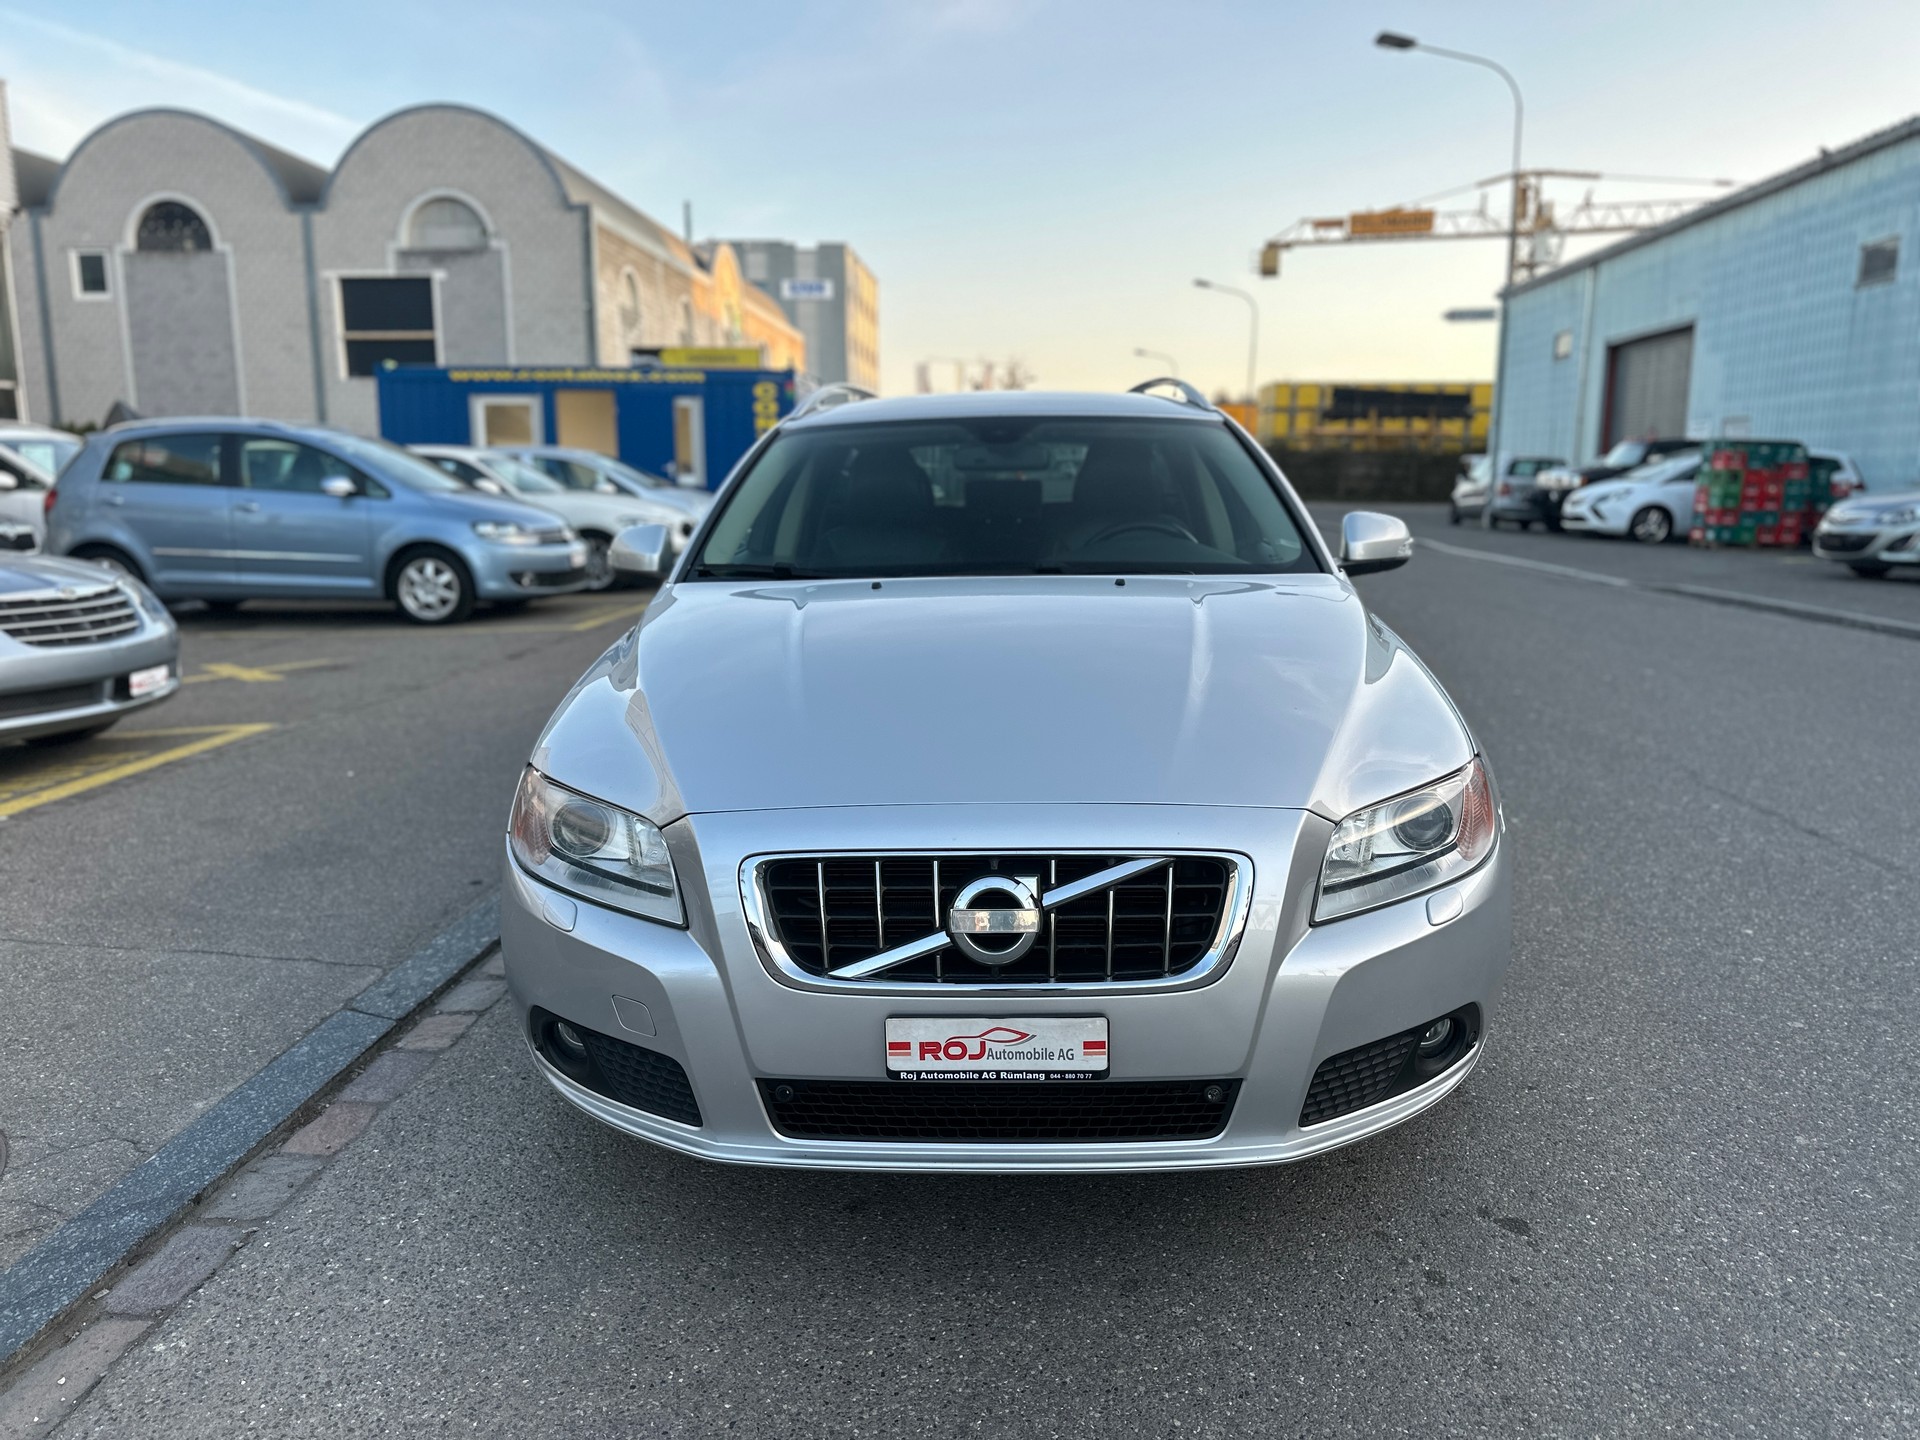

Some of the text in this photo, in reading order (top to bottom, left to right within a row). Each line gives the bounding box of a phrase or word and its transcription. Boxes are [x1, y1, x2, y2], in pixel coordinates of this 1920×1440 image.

[919, 1041, 1075, 1061] ROJ Automobile AG
[900, 1071, 917, 1081] Roj
[920, 1071, 980, 1080] Automobile
[982, 1071, 997, 1080] AG
[1000, 1071, 1046, 1081] Rümlang
